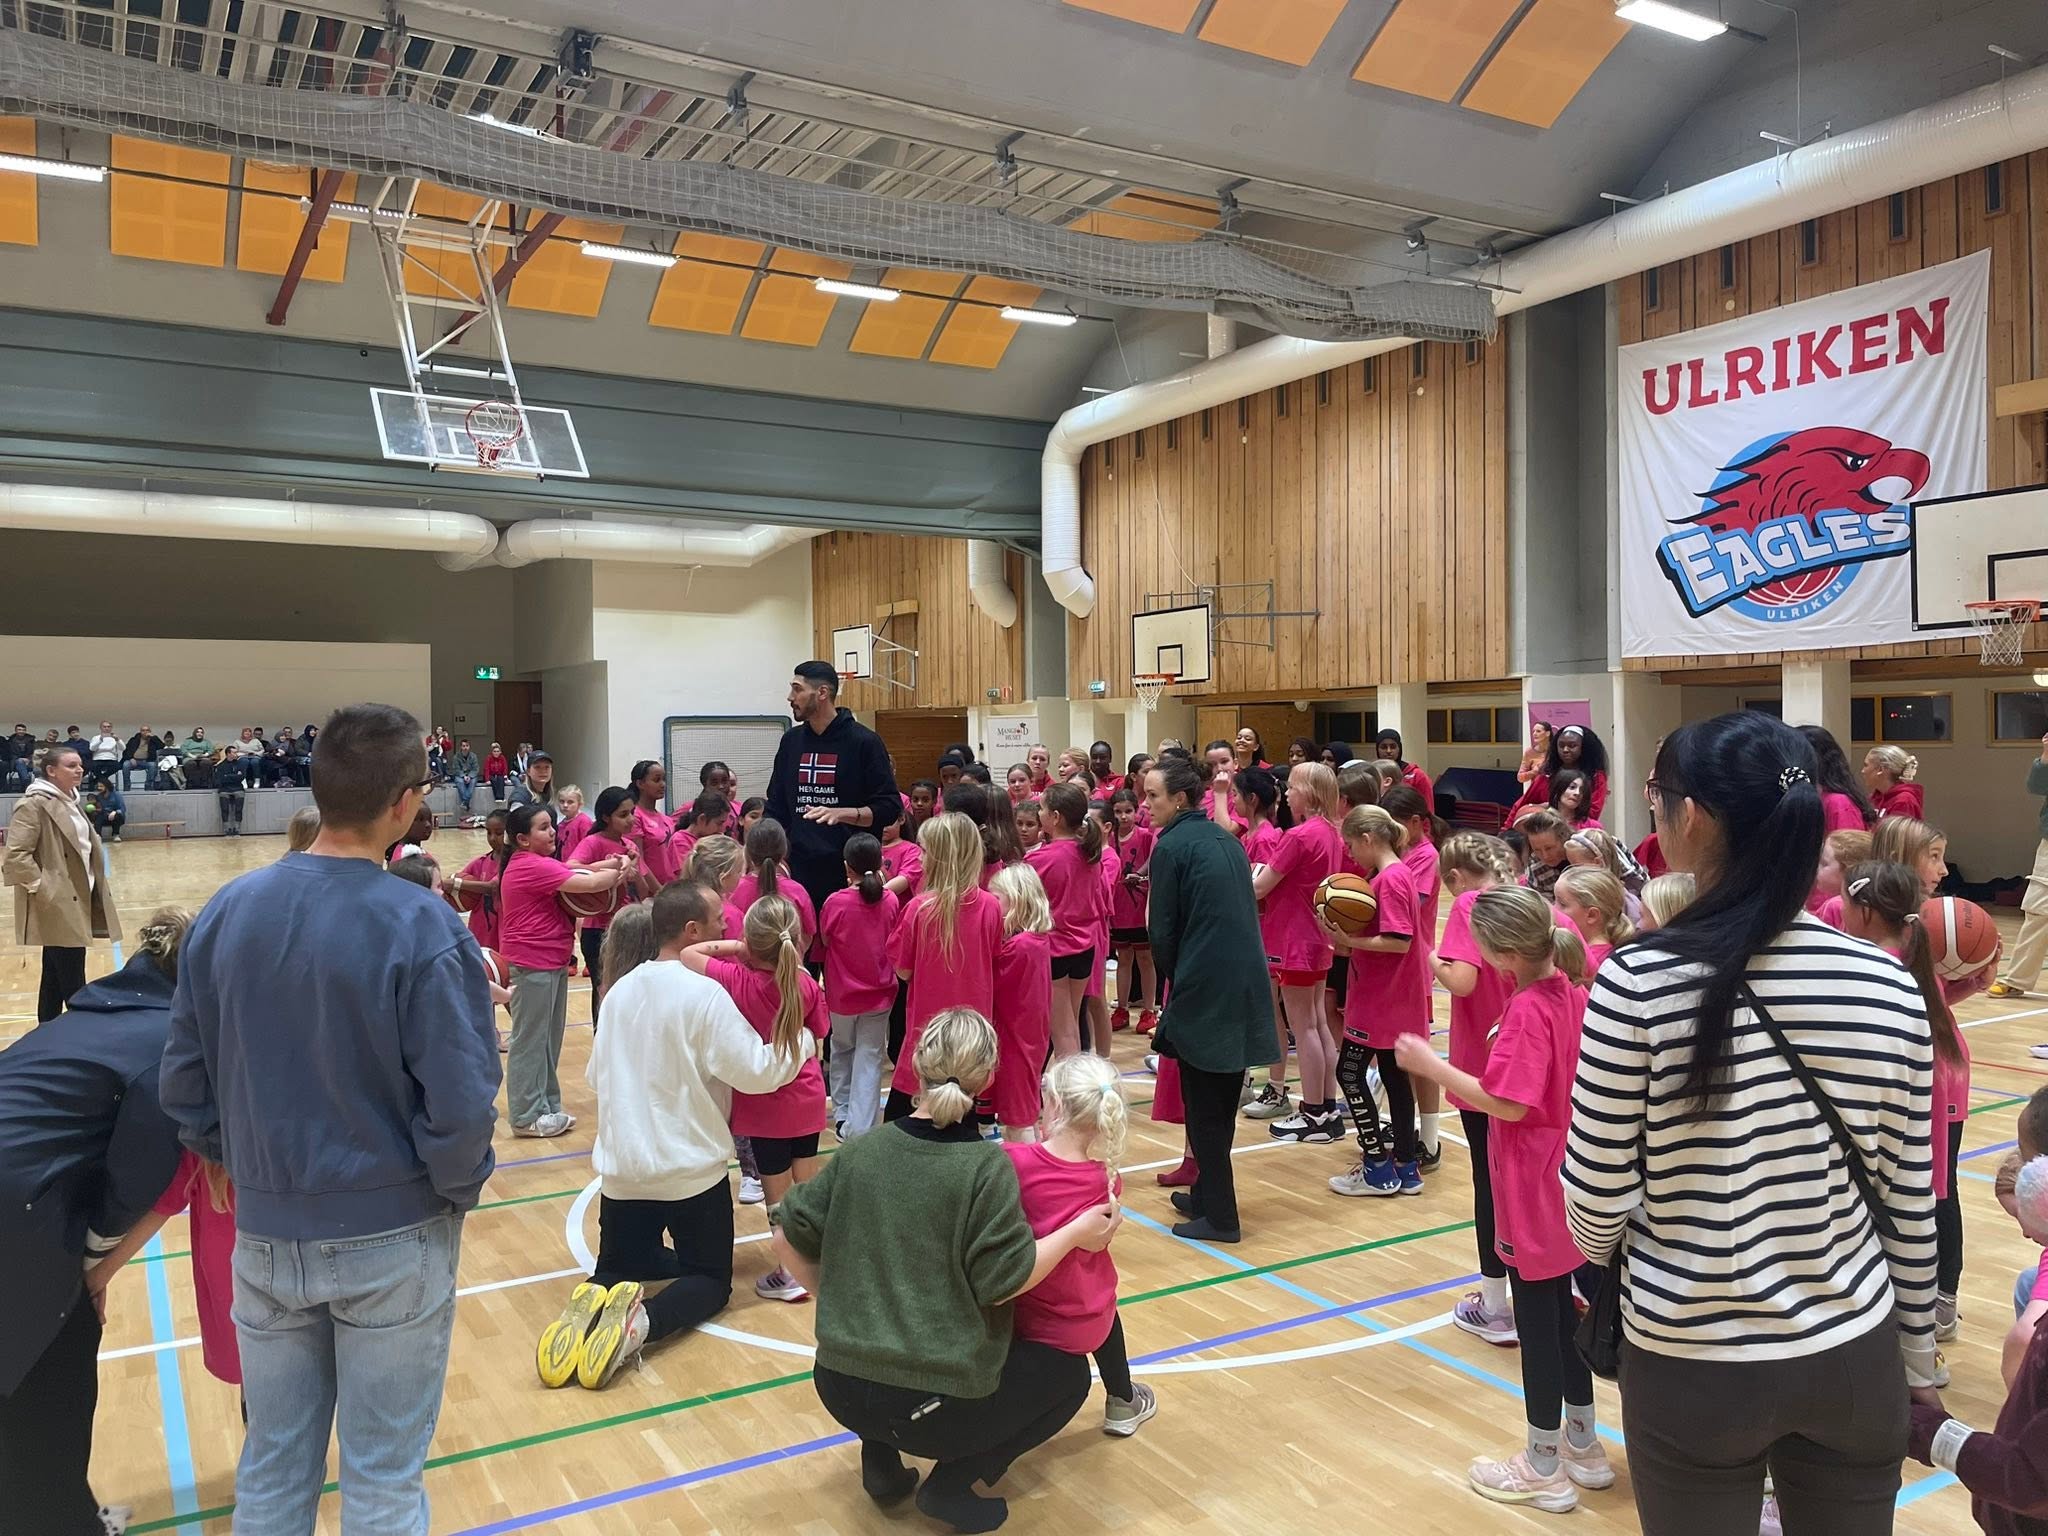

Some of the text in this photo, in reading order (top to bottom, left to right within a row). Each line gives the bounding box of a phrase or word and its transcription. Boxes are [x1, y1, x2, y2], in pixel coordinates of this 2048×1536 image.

[1642, 296, 1950, 416] ULRIKEN
[1667, 510, 1911, 605] EAGLES
[1766, 581, 1844, 619] ULRIKEN
[797, 796, 839, 805] HER DREAM
[798, 785, 835, 794] HER GAME
